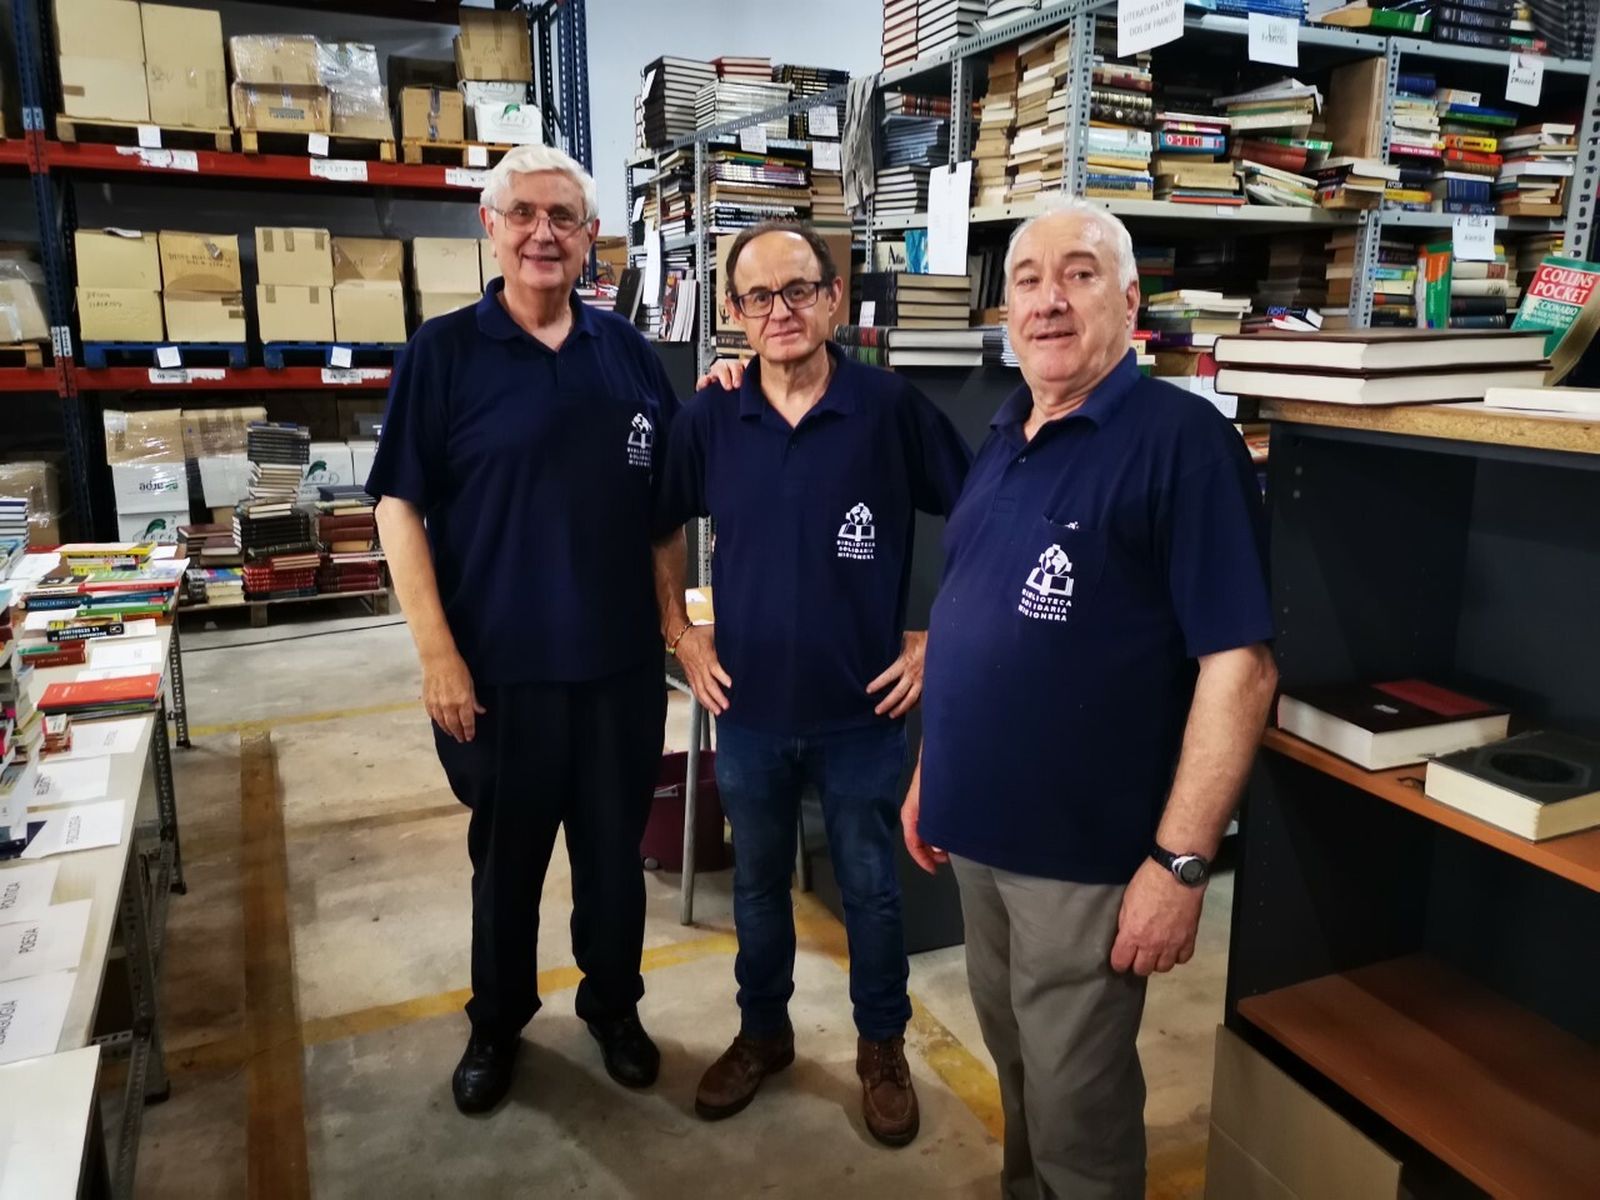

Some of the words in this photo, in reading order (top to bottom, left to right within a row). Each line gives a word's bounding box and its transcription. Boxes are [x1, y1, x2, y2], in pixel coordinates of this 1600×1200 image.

[1541, 267, 1595, 288] COLLINS
[1533, 281, 1589, 303] POCKET
[1021, 588, 1072, 607] BIBLIOTECA
